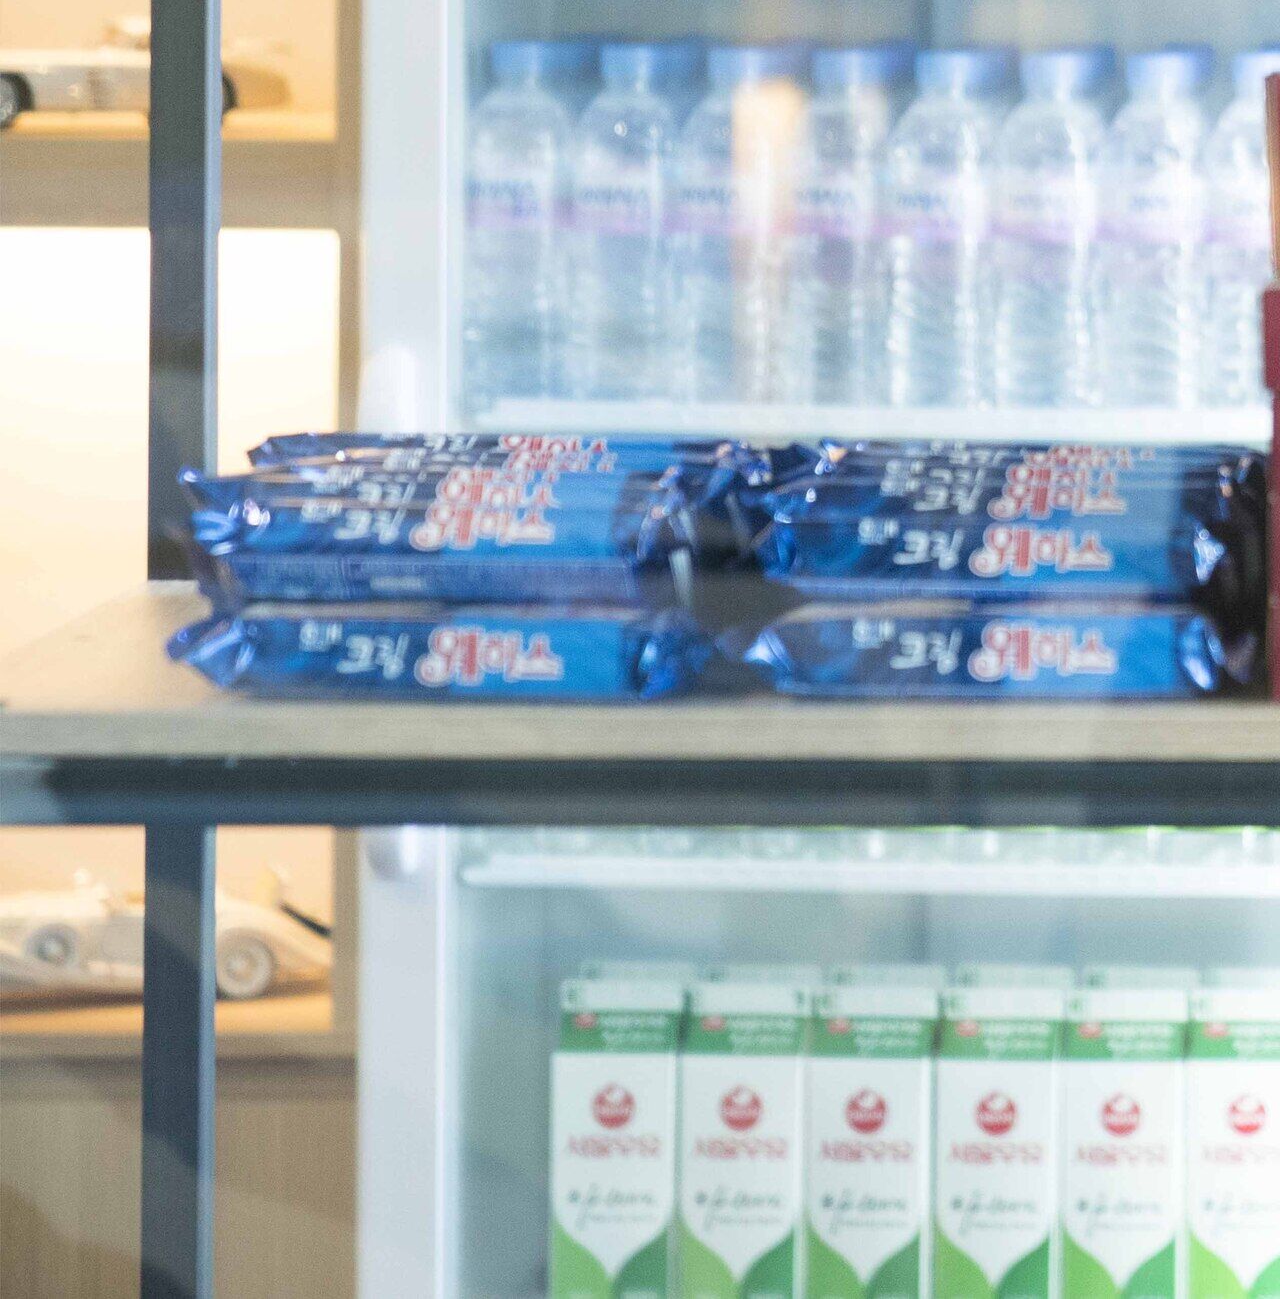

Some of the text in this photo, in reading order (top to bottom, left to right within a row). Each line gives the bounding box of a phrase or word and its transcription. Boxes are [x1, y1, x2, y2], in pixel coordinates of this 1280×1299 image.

[968, 522, 1115, 578] 웨하스
[414, 625, 564, 688] 웨하스
[967, 621, 1119, 683] 웨하스
